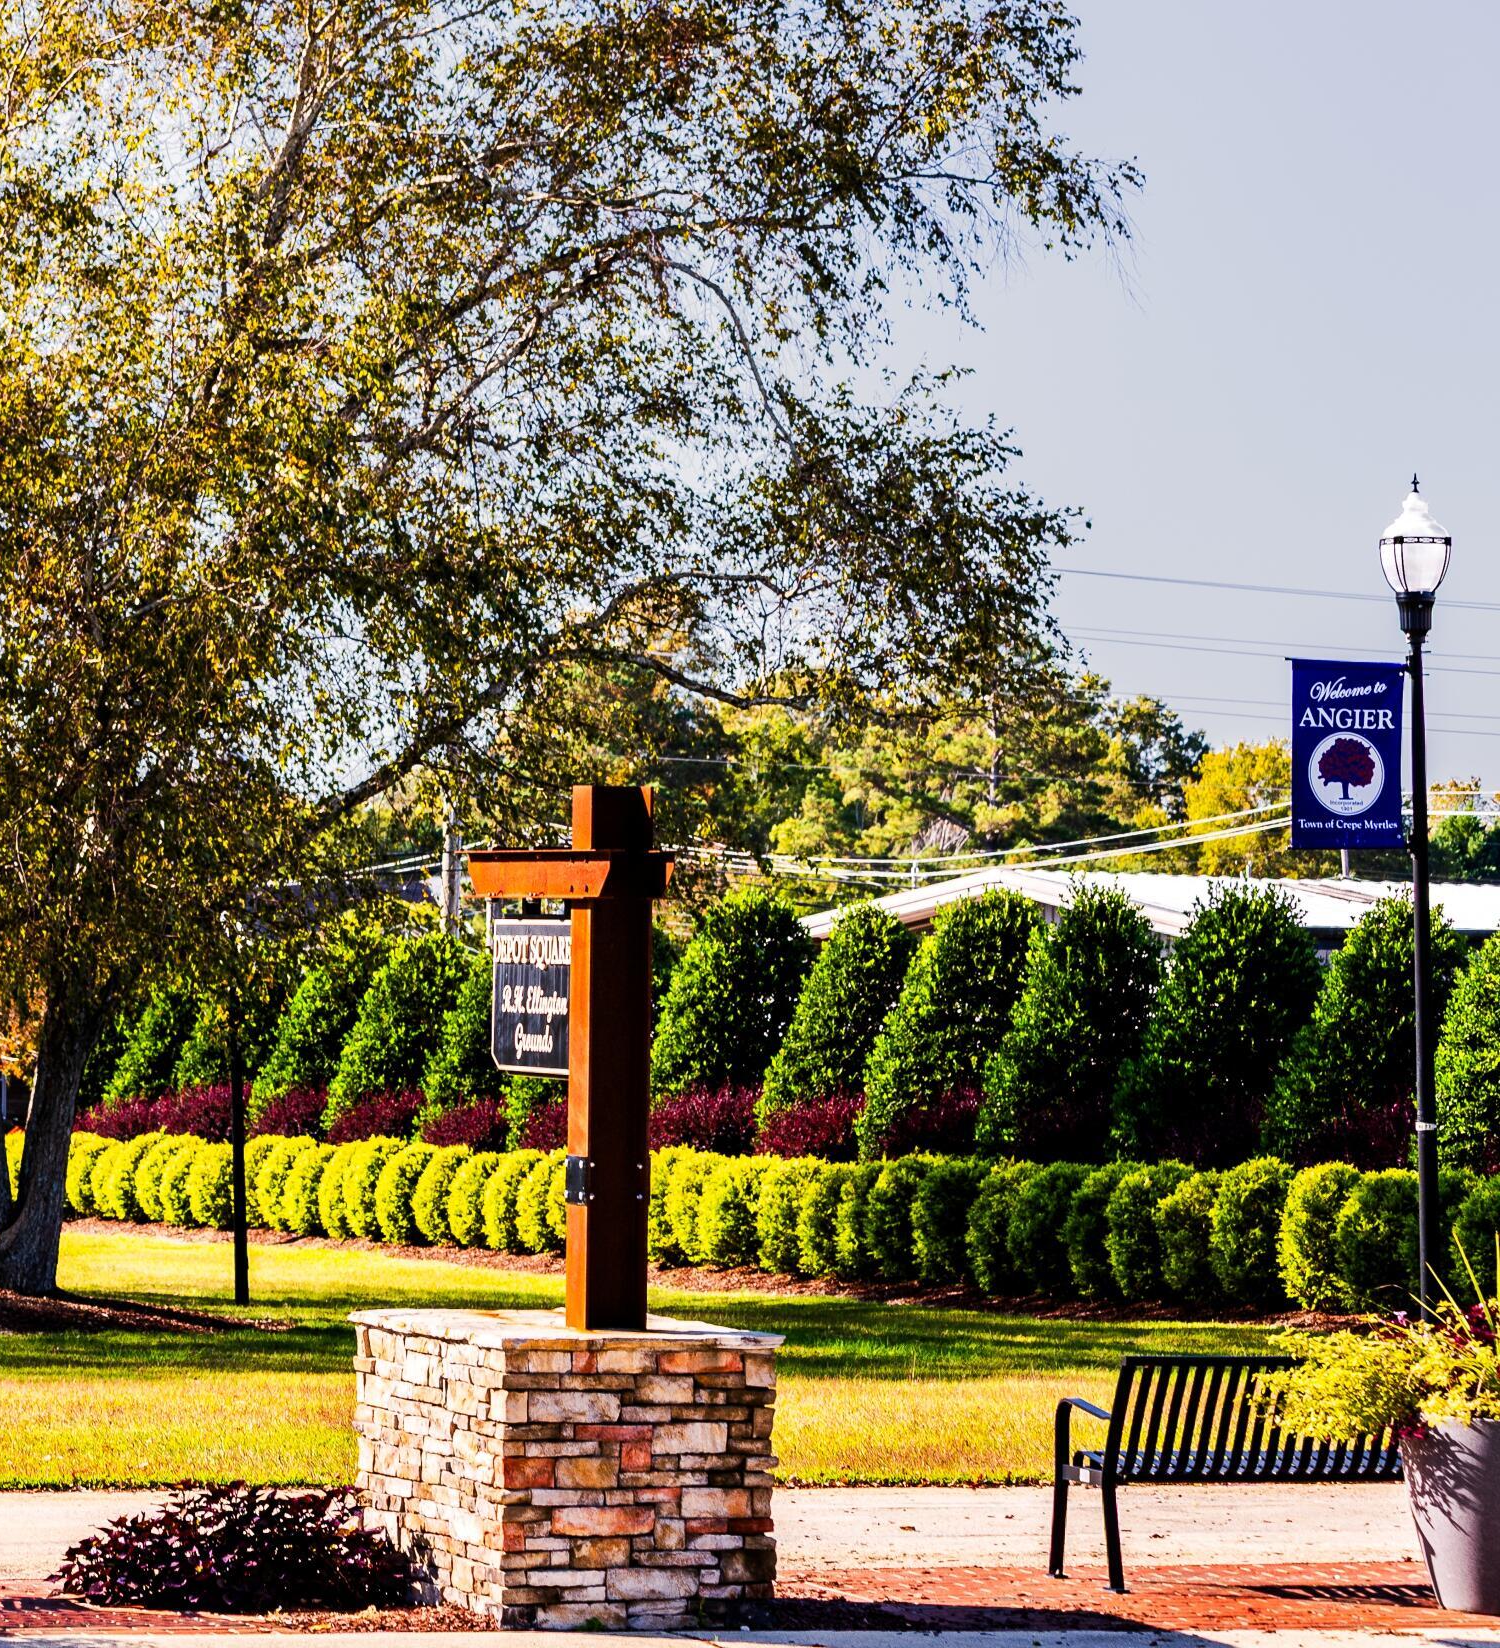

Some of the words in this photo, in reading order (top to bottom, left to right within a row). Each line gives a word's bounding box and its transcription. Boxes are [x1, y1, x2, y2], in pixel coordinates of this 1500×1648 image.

[1310, 676, 1372, 702] Welcome
[1373, 681, 1388, 694] to
[1299, 706, 1396, 730] ANGIER
[1298, 819, 1323, 829] Town
[1325, 819, 1334, 829] of
[1335, 819, 1362, 831] Crepe
[1364, 819, 1398, 831] Myrtles
[493, 935, 529, 964] DEPOT
[529, 935, 572, 970] SQUARE
[502, 985, 525, 1014] R.H.
[526, 985, 568, 1023] Ellington
[515, 1023, 553, 1060] Grounds
